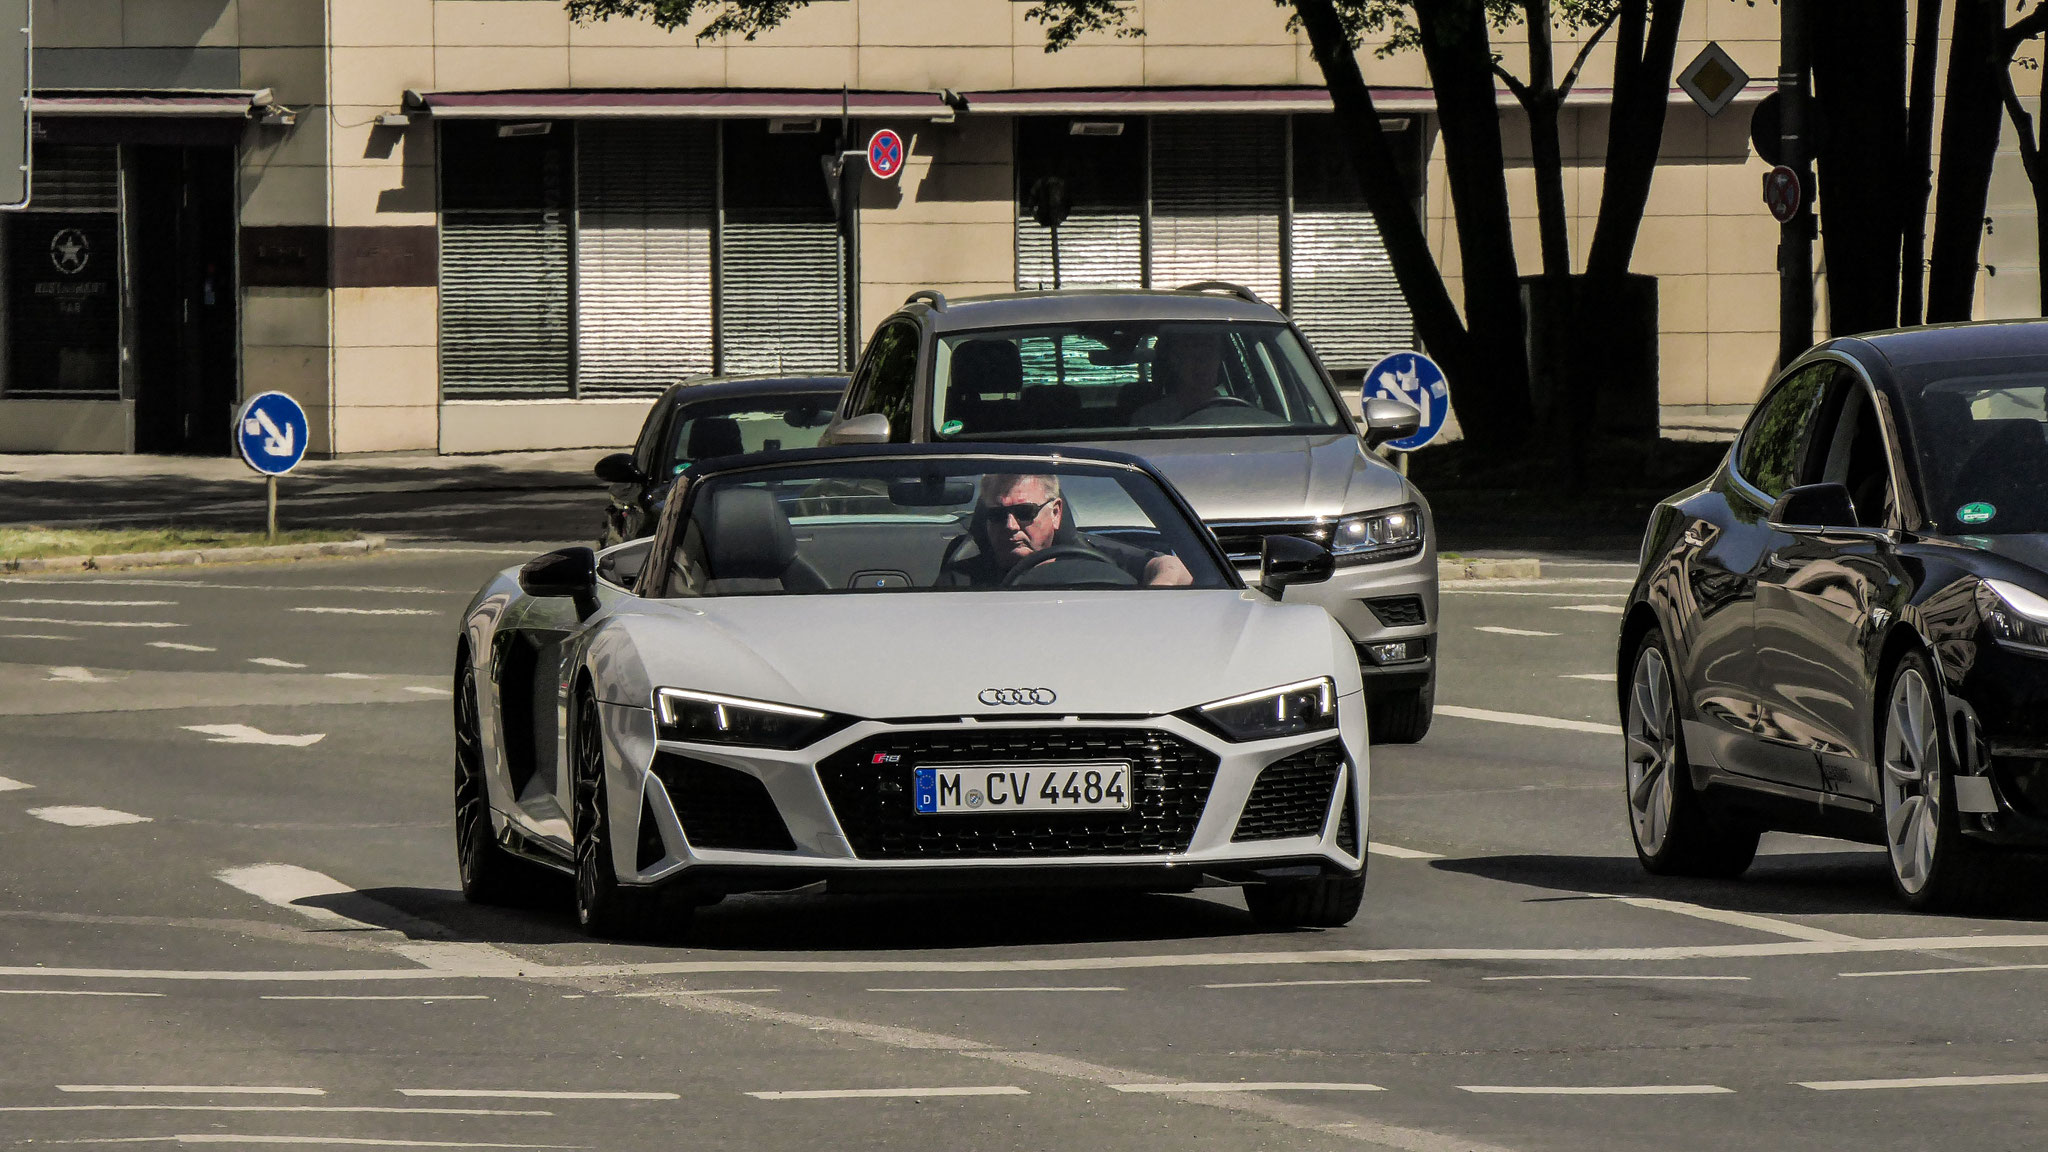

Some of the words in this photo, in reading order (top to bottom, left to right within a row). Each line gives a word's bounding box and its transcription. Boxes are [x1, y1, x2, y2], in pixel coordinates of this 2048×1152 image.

[872, 753, 901, 764] R8
[940, 773, 962, 806] M
[986, 772, 1031, 805] CV
[1040, 771, 1125, 804] 4484
[923, 795, 931, 805] D
